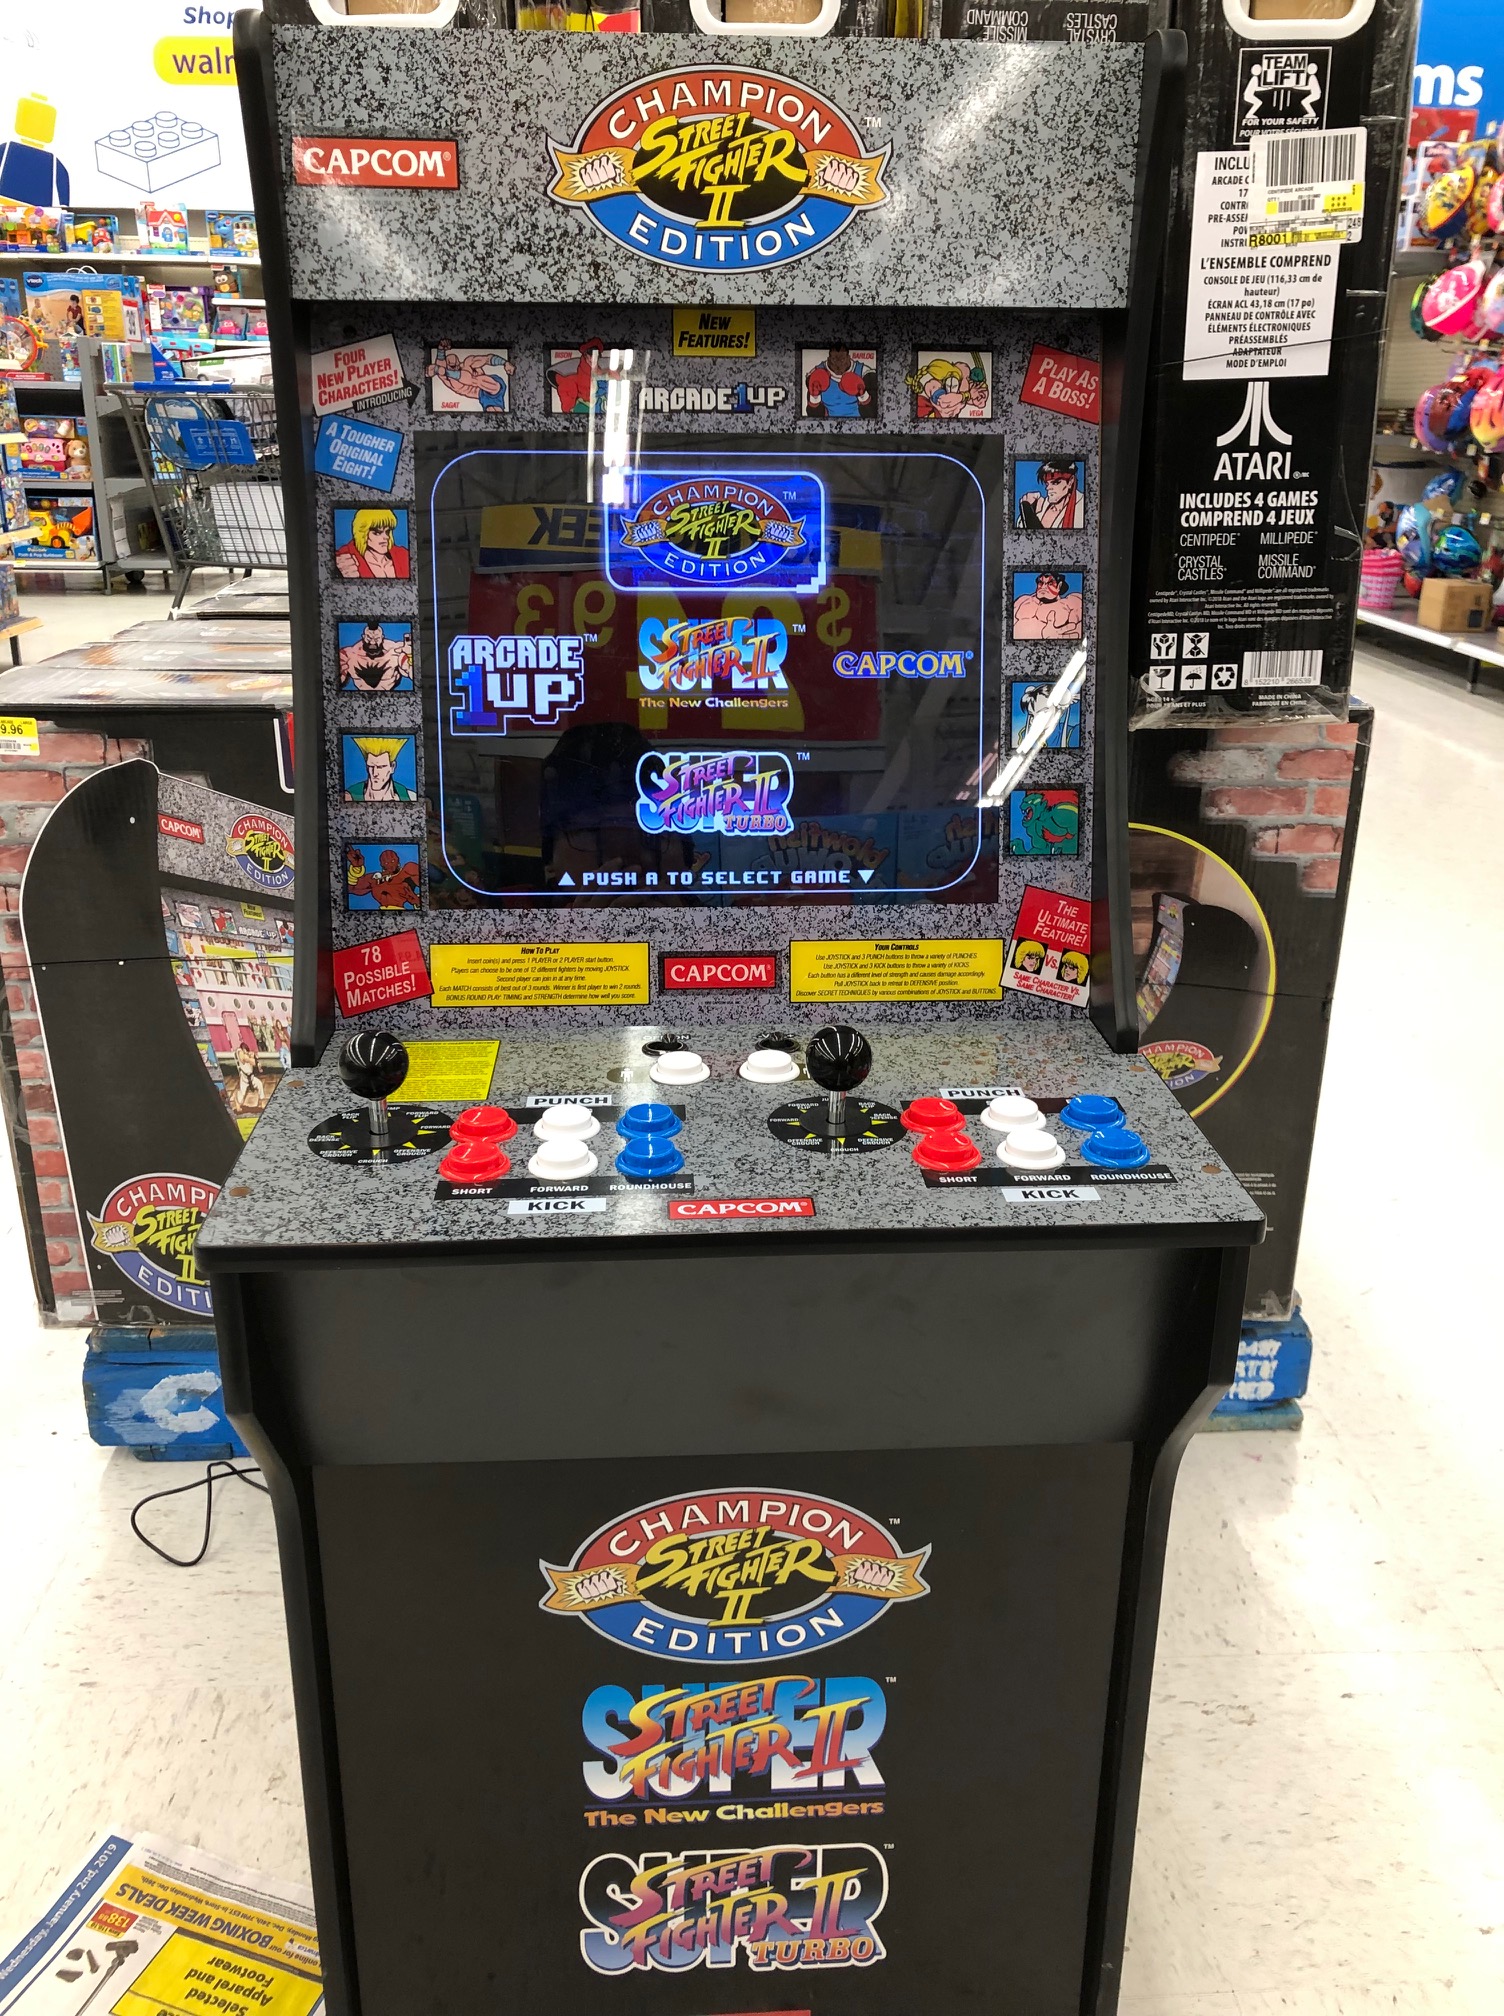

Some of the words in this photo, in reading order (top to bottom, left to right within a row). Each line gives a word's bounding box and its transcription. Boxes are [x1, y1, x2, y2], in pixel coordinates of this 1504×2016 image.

[967, 9, 1028, 25] COMMAND
[1067, 12, 1118, 29] CASTLES
[983, 25, 1027, 41] MISSILE
[1067, 28, 1116, 43] CRYSTAL
[1264, 55, 1307, 69] TEAM
[1262, 69, 1305, 86] LIFT
[608, 80, 832, 143] CHAMPION
[1241, 118, 1260, 126] FOR
[1261, 118, 1285, 126] YOUR
[1286, 117, 1319, 125] SAFETY
[631, 112, 751, 182] STREET
[304, 147, 445, 178] CAPCOM
[657, 129, 810, 191] FIGHTER
[1214, 157, 1249, 170] INCLU
[1212, 176, 1243, 185] ARCADE
[628, 211, 815, 262] EDITION
[1201, 256, 1266, 270] L'ENSEMBLE
[1270, 255, 1331, 268] COMPREND
[1204, 276, 1238, 285] CONSOLE
[1240, 275, 1250, 284] DE
[1251, 275, 1265, 284] JEU
[1312, 274, 1322, 283] de
[1244, 287, 1280, 297] hauteur)
[1208, 299, 1233, 309] ÉCRAN
[1235, 300, 1248, 309] ACL
[1250, 300, 1272, 309] 43,18
[1287, 299, 1300, 309] (17
[699, 314, 732, 330] NEW
[1205, 311, 1241, 321] PANNEAU
[1243, 311, 1253, 320] DE
[1255, 310, 1294, 320] CONTRÔLE
[1296, 310, 1316, 319] AVEC
[1208, 323, 1247, 333] ÉLÉMENTS
[1249, 322, 1311, 332] ÉLECTRONIQUES
[678, 331, 750, 348] FEATURES!
[1229, 334, 1288, 345] PRÉASSEMBLÉS
[334, 349, 366, 368] FOUR
[1226, 359, 1248, 368] MODE
[1250, 358, 1287, 367] D'EMPLOI
[317, 372, 344, 391] NEW
[347, 358, 392, 382] PLAYER
[1039, 358, 1077, 383] PLAY
[1077, 367, 1099, 390] AS
[319, 370, 399, 407] CHARACTERS!
[356, 387, 413, 411] INTRODUCING
[1032, 380, 1046, 395] A
[1049, 384, 1096, 409] BOSS!
[326, 422, 336, 437] A
[341, 424, 395, 453] TOUGHER
[330, 440, 383, 467] ORIGINAL
[332, 458, 376, 480] EIGHT!
[1213, 452, 1292, 481] ATARI
[653, 485, 774, 516] CHAMPION
[1179, 493, 1251, 509] INCLUDES
[1254, 493, 1264, 507] 4
[1267, 491, 1318, 507] GAMES
[666, 501, 729, 536] STREET
[679, 509, 761, 541] FIGHTER
[1180, 511, 1263, 527] COMPREND
[1266, 511, 1276, 526] 4
[1278, 509, 1315, 525] JEUX
[1180, 533, 1237, 547] CENTIPEDE
[1260, 532, 1313, 545] MILLIPEDE
[664, 552, 765, 577] EDITION
[1178, 555, 1223, 568] CRYSTAL
[1258, 554, 1299, 567] MISSILE
[1178, 568, 1224, 581] CASTLES
[1257, 566, 1313, 579] COMMAND
[652, 616, 752, 664] STREET
[453, 637, 580, 670] ARCADE
[657, 642, 744, 691] FIGHTER
[835, 652, 966, 678] CAPCOM
[639, 697, 664, 708] The
[669, 697, 701, 708] New
[705, 697, 788, 709] Challengers
[652, 753, 754, 800] STREET
[658, 780, 746, 827] FIGHTER
[160, 818, 201, 838] CAPCOM
[237, 819, 288, 849] CHAMPION
[724, 815, 790, 831] TURBO
[246, 863, 289, 885] EDITION
[583, 873, 637, 886] PUSH
[646, 872, 658, 885] A
[665, 871, 692, 885] TO
[702, 871, 780, 885] SELECT
[791, 870, 850, 884] GAME
[1057, 900, 1079, 917] THE
[1038, 909, 1088, 934] ULTIMATE
[1033, 922, 1087, 947] FEATURE!
[361, 946, 382, 965] 78
[545, 946, 560, 954] PLAY
[891, 943, 919, 951] CONTROLS
[343, 961, 410, 990] POSSIBLE
[670, 963, 767, 983] CAPCOM
[1033, 977, 1070, 991] CHARACTER
[347, 974, 416, 1008] MATCHES!
[534, 1096, 609, 1106] PUNCH
[947, 1089, 1020, 1098] PUNCH
[1013, 1174, 1071, 1182] FORWARD
[1090, 1172, 1172, 1181] ROUNDHOUSE
[116, 1182, 214, 1217] CHAMPI
[452, 1187, 493, 1195] SHORT
[530, 1184, 589, 1193] FORWARD
[610, 1182, 692, 1191] ROUNDHOUSE
[1021, 1188, 1080, 1199] KICK
[528, 1200, 585, 1211] KICK
[677, 1202, 801, 1215] CAPCOM
[608, 1500, 865, 1557] CHAMPION
[635, 1525, 771, 1594] STREET
[668, 1539, 839, 1597] FIGHTER
[707, 1587, 771, 1627] II
[632, 1607, 844, 1654] EDITION
[607, 1674, 816, 1757] STREET
[619, 1715, 802, 1799] FIGHTER
[584, 1811, 636, 1828] The
[645, 1808, 709, 1825] New
[716, 1801, 885, 1822] Challengers
[49, 1889, 81, 1929] January
[79, 1869, 99, 1890] 2nd,
[94, 1843, 117, 1868] 2019
[608, 1850, 813, 1928] STREET
[115, 1883, 169, 1912] DEALS
[165, 1901, 212, 1928] WEEK
[209, 1917, 274, 1948] BOXING
[620, 1886, 804, 1966] FIGHTER
[752, 1937, 876, 1965] TURBO
[184, 1968, 216, 1985] and
[207, 1956, 275, 1988] Footwear
[213, 1978, 273, 2006] Apparel
